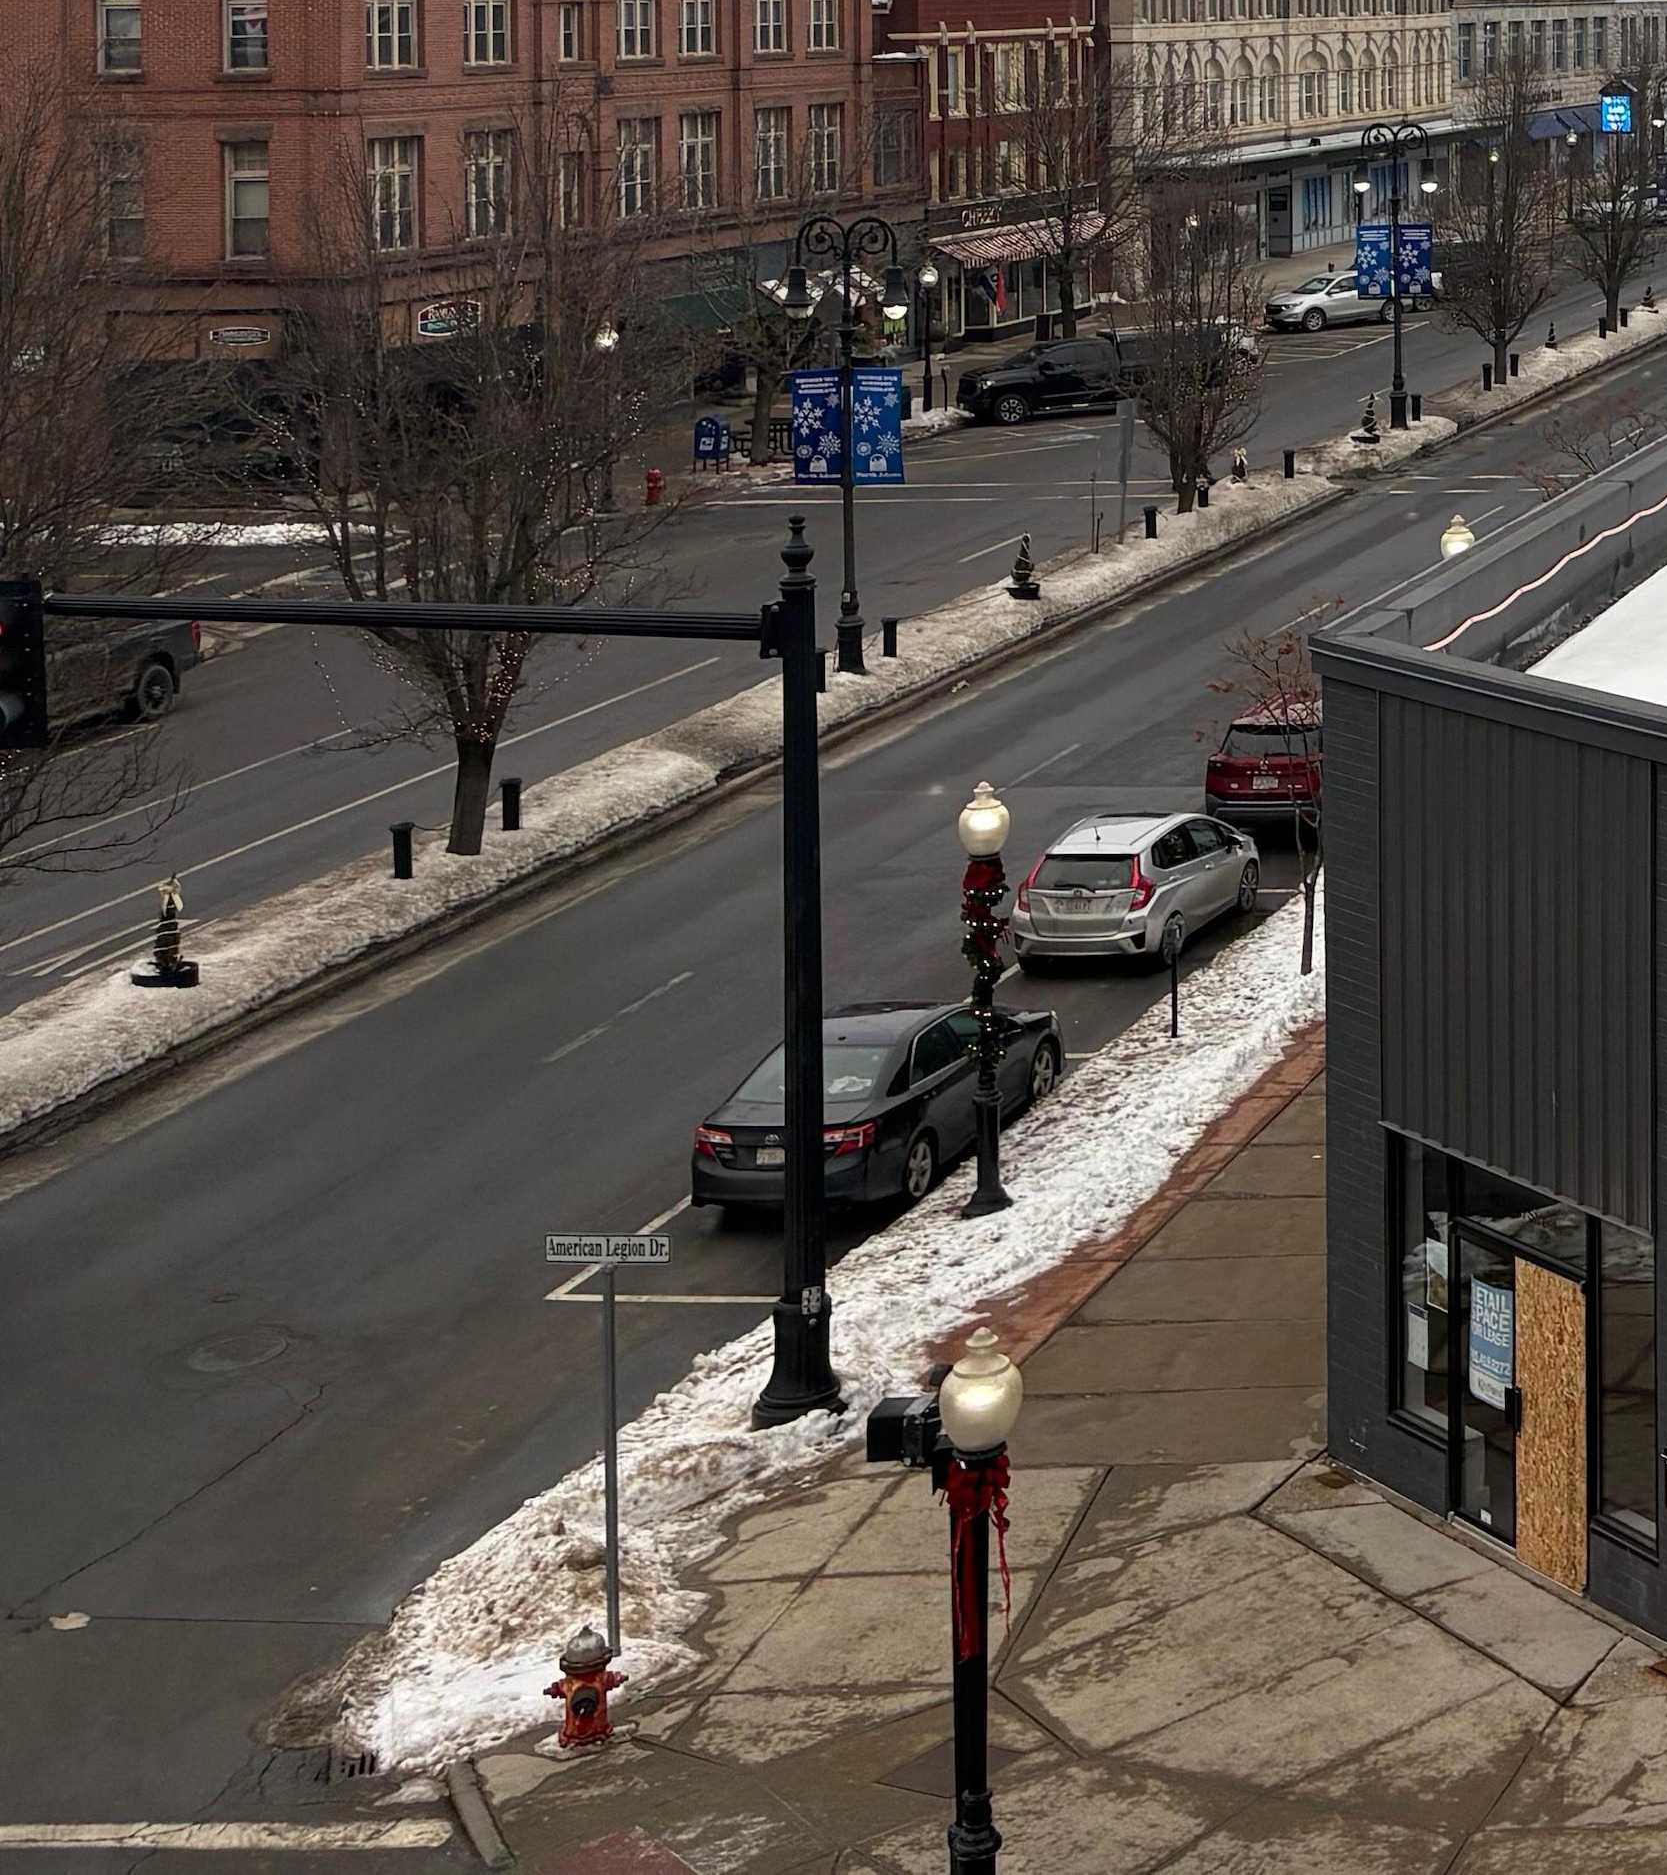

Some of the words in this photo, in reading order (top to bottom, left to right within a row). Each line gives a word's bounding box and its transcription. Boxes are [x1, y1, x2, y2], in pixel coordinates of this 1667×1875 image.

[548, 1237, 602, 1257] American
[606, 1238, 646, 1260] Legion
[650, 1238, 668, 1256] Dr.
